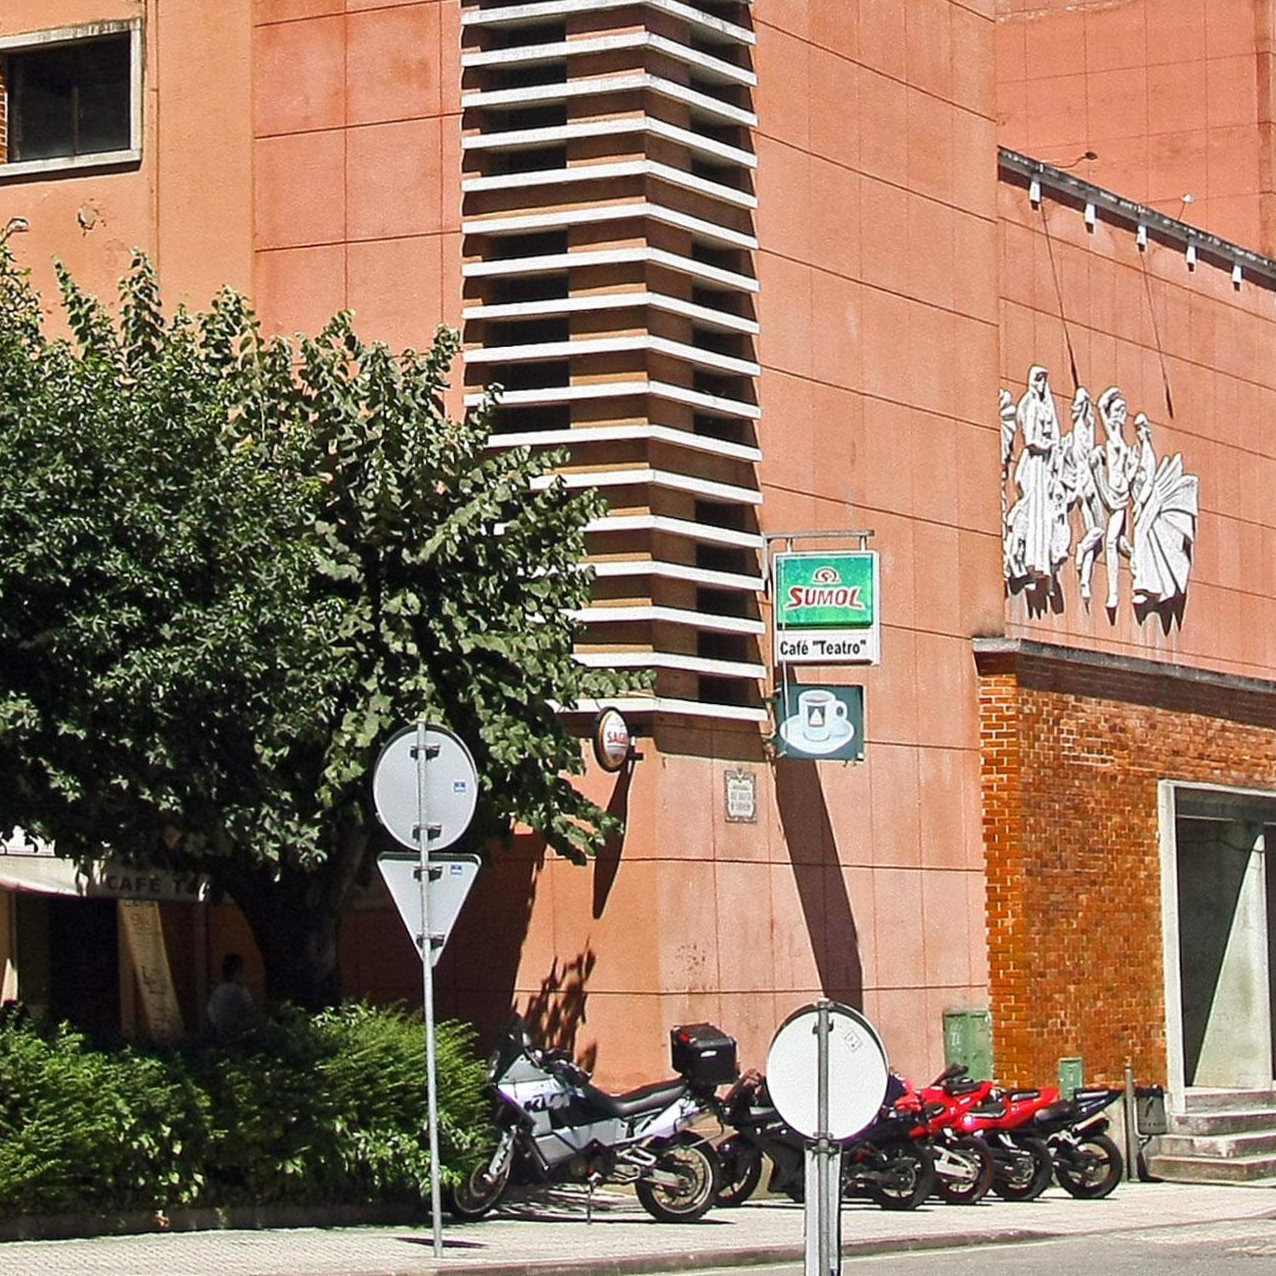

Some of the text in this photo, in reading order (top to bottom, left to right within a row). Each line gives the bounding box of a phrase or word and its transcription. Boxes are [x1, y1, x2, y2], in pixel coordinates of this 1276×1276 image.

[785, 585, 866, 611] SUMOL
[779, 639, 867, 657] Café "Teatro"
